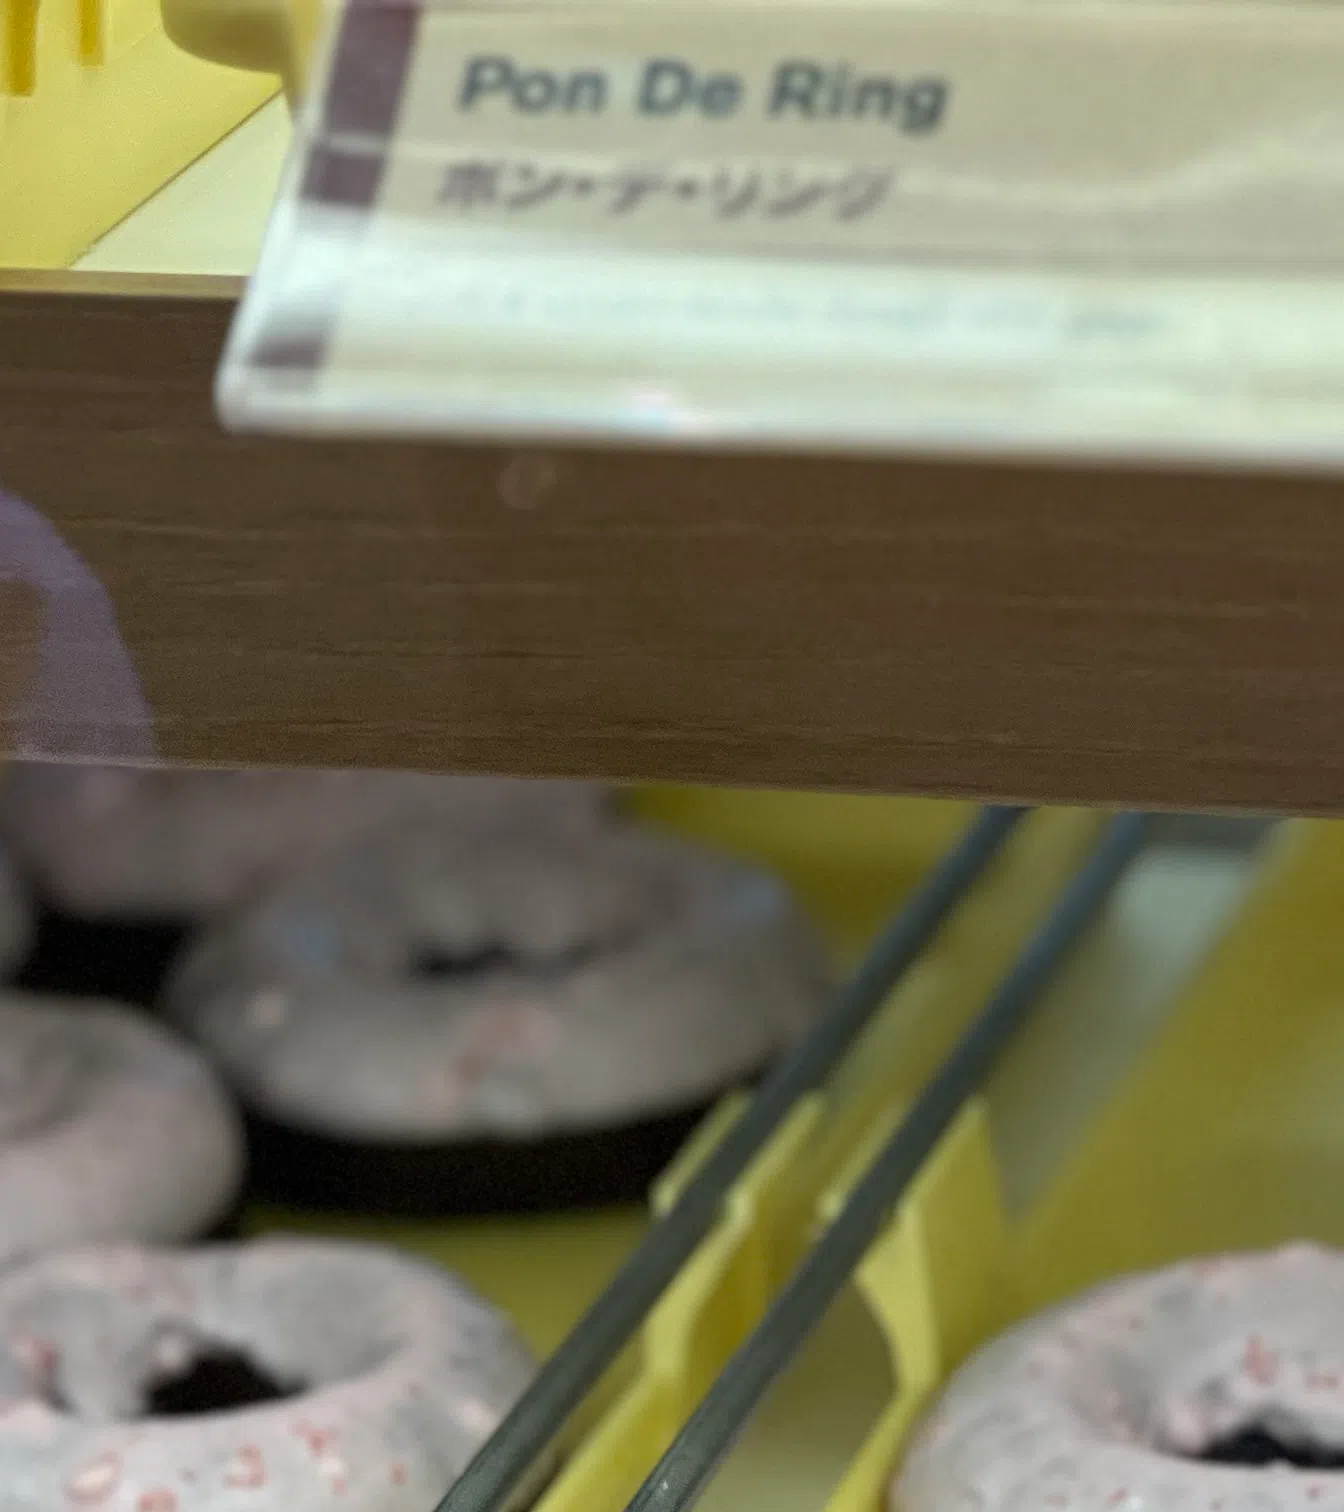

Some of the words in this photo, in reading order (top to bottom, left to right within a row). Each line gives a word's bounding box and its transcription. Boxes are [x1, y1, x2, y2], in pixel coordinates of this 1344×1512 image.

[459, 54, 609, 116] Pon
[636, 57, 746, 119] De
[766, 58, 952, 137] Ring
